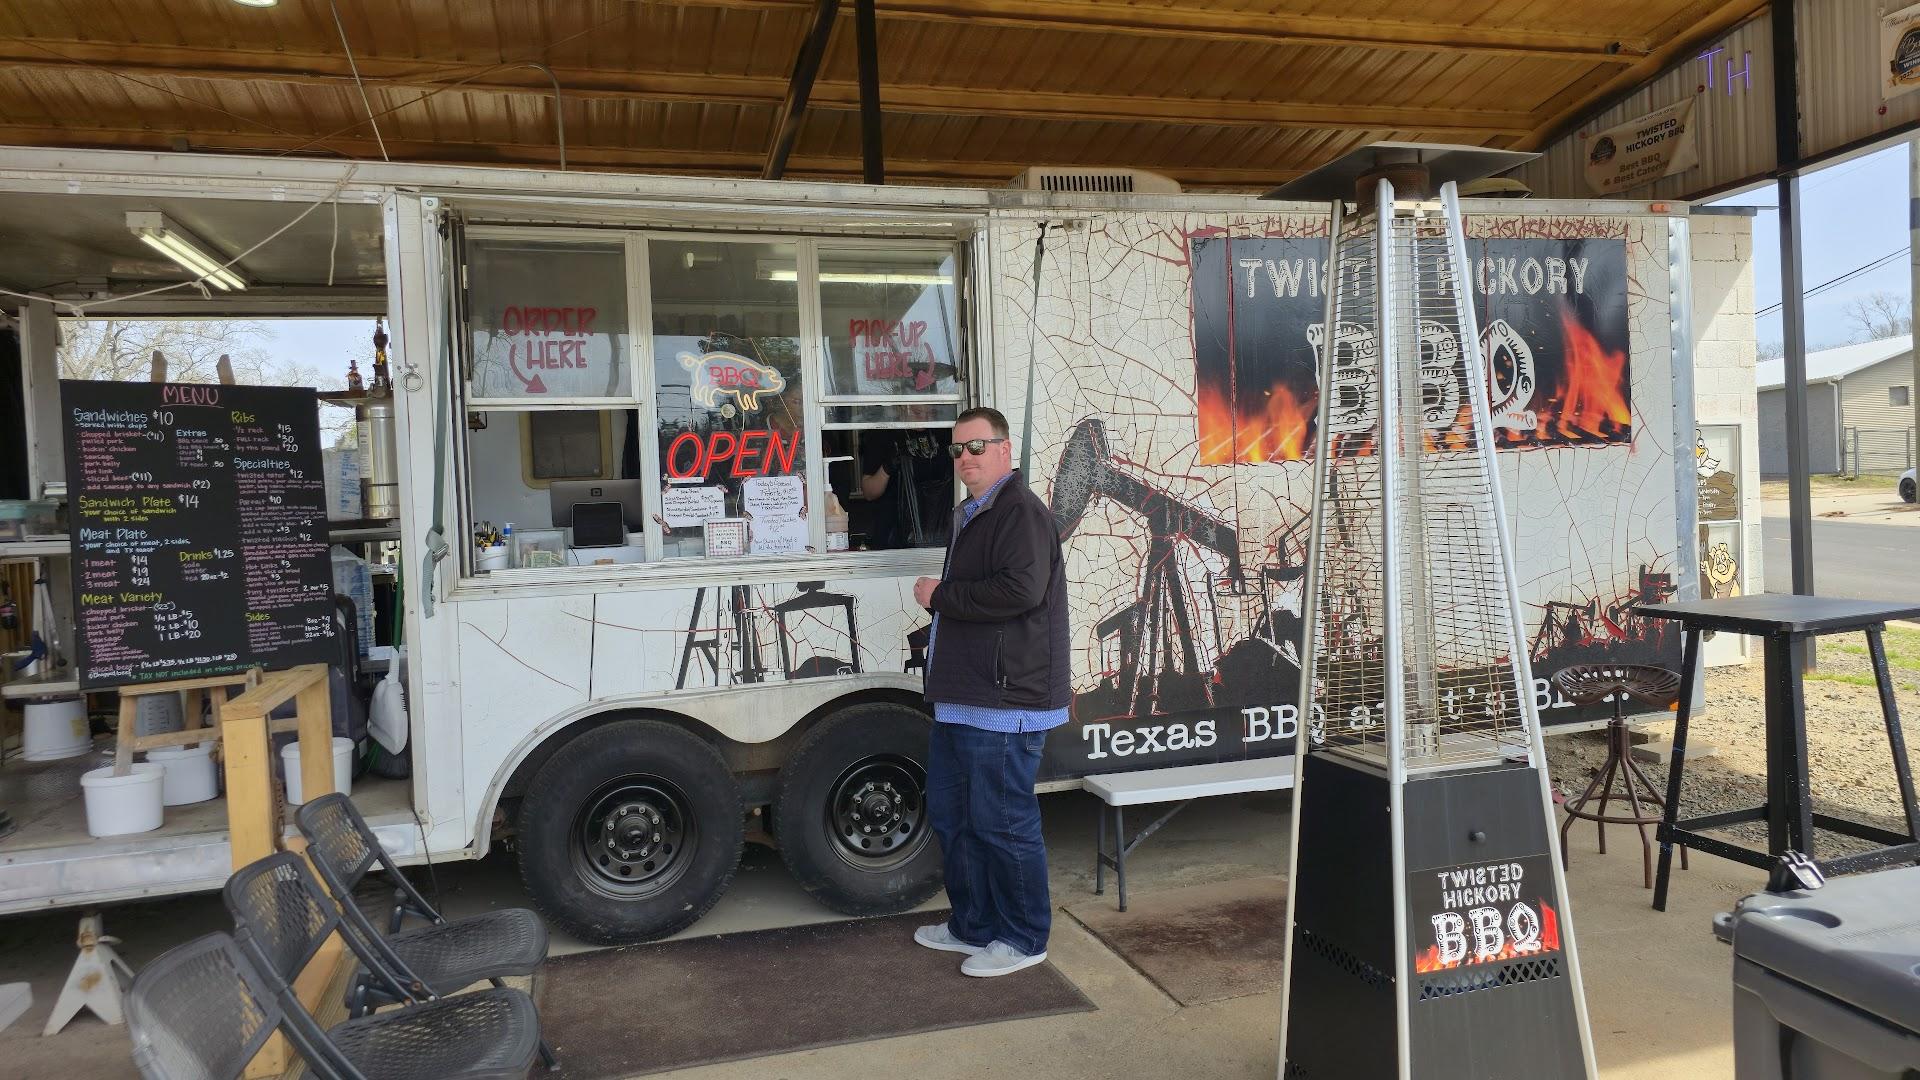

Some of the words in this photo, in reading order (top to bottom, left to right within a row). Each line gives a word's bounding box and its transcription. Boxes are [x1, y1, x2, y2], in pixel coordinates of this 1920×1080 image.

[1696, 48, 1750, 96] TH
[1636, 118, 1677, 139] TWISTED
[1626, 132, 1666, 153] HICKORY
[1668, 124, 1686, 138] BBQ
[1619, 160, 1639, 173] Best
[1641, 152, 1660, 165] BBQ
[1613, 171, 1634, 184] Best
[1240, 256, 1368, 297] TWIT
[503, 304, 597, 337] ORDER
[848, 318, 928, 348] PICK-UP
[526, 339, 588, 370] HERE
[865, 351, 913, 380] HERE
[709, 366, 760, 388] BBQ
[163, 385, 219, 405] MENU
[73, 408, 148, 423] Sandwiches
[153, 409, 174, 425] $10
[231, 411, 255, 423] Ribs
[176, 429, 208, 437] Extras
[278, 423, 292, 433] $15
[278, 434, 294, 444] $30
[282, 443, 299, 453] $20
[666, 430, 800, 479] OPEN
[234, 457, 291, 470] Specialties
[290, 469, 304, 479] $12
[148, 483, 159, 491] any
[79, 495, 136, 509] Sandwich
[142, 496, 171, 507] Plate
[178, 494, 200, 509] $14
[269, 495, 282, 504] $10
[142, 507, 177, 515] sandwich
[80, 528, 112, 541] Meat
[116, 528, 149, 540] Plate
[300, 533, 312, 541] $12
[91, 559, 117, 567] meat
[131, 554, 148, 566] $14
[179, 550, 213, 562] Drinks
[84, 571, 92, 579] 2
[92, 570, 118, 578] meat
[131, 566, 149, 577] $19
[93, 580, 120, 588] meat
[131, 577, 150, 587] $24
[81, 593, 114, 606] Meat
[120, 592, 163, 603] Variety
[154, 614, 166, 622] 1/4
[245, 612, 271, 622] Sides
[154, 623, 166, 632] 1/2
[140, 672, 153, 680] TAX
[155, 670, 169, 678] NOT
[171, 668, 202, 676] included
[1083, 719, 1219, 760] Texas
[1437, 862, 1524, 890] TWISTED
[1442, 882, 1521, 909] HICKORY
[1431, 901, 1541, 965] BBQ
